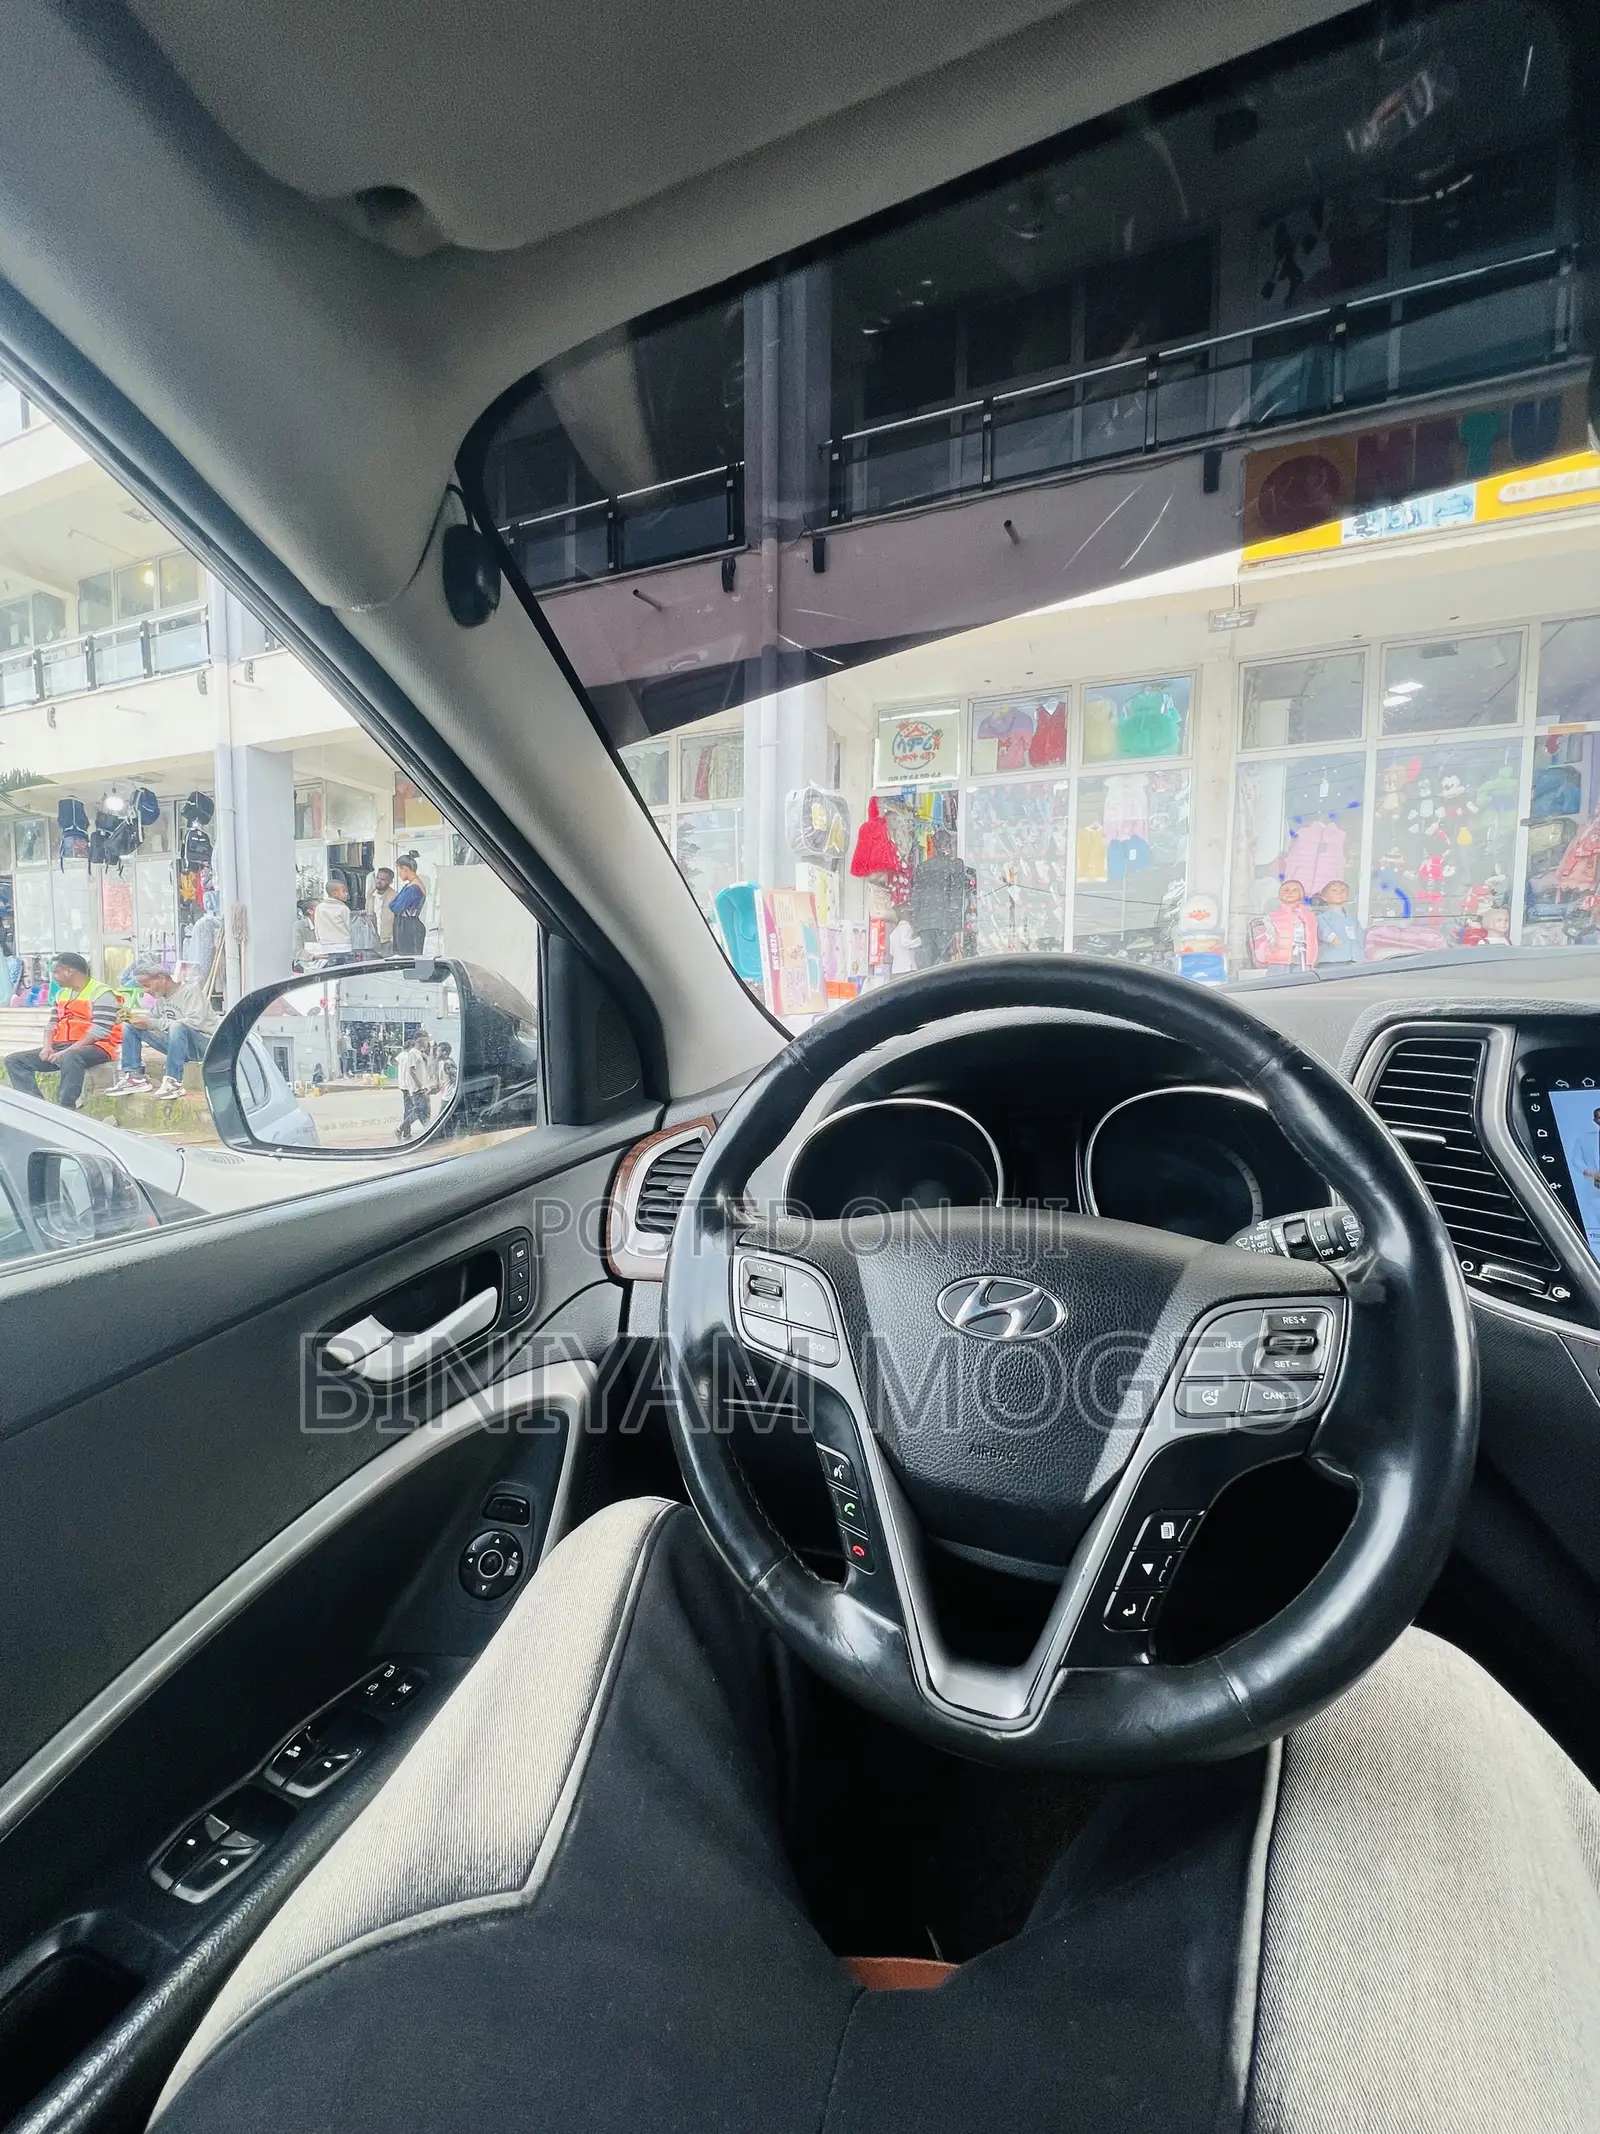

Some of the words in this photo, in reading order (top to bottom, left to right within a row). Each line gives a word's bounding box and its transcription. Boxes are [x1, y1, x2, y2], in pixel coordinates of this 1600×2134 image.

[1316, 1234, 1326, 1242] LO
[1256, 1241, 1269, 1249] OFF
[1321, 1247, 1335, 1257] OFF
[1213, 1340, 1243, 1349] CRUISE
[1262, 1391, 1300, 1401] CANCEL
[512, 1551, 519, 1559] R
